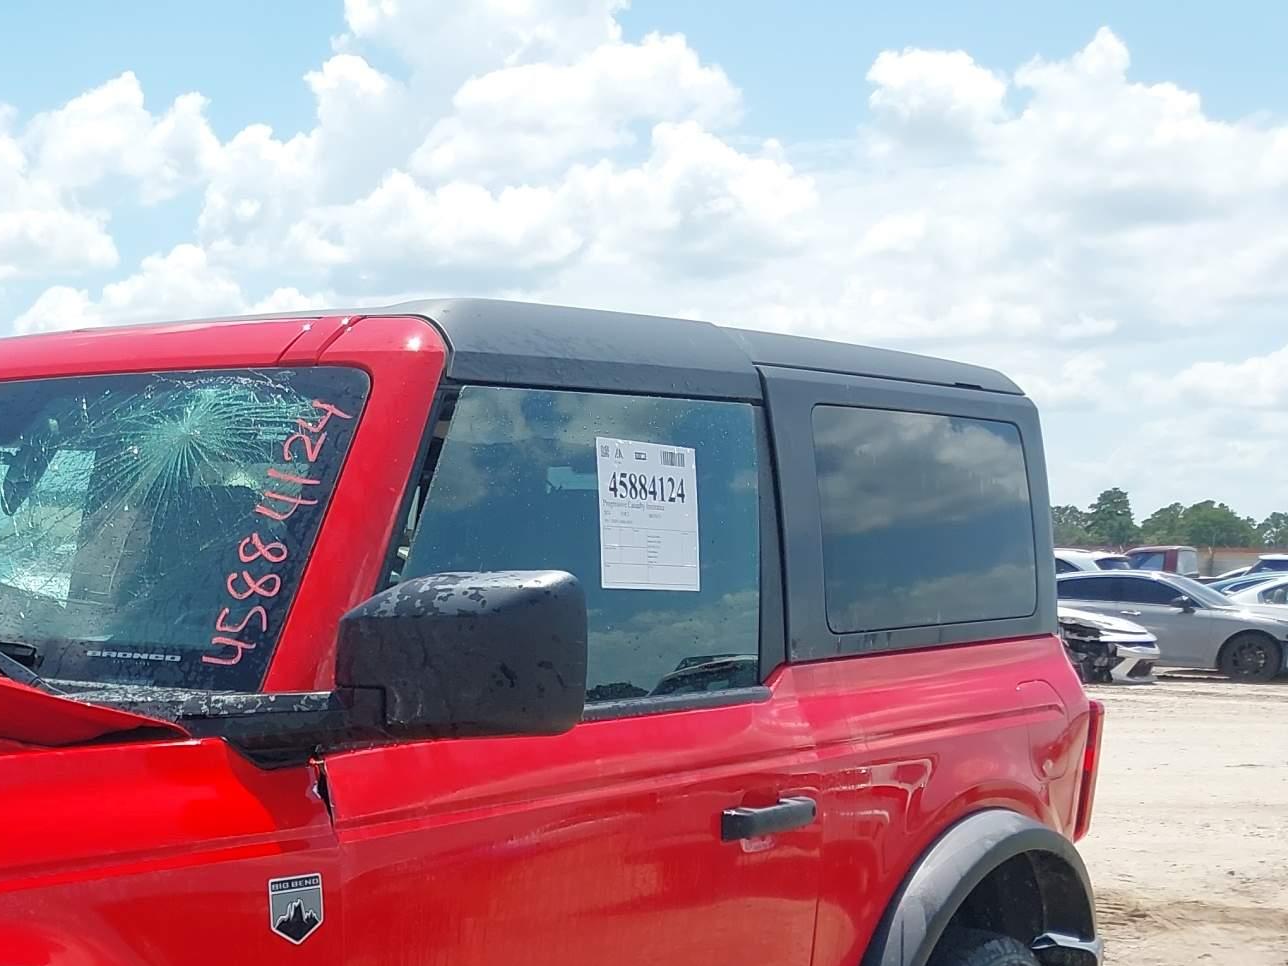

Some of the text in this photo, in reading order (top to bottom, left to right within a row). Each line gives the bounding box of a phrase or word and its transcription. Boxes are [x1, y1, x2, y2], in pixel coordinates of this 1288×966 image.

[608, 471, 686, 504] 45884124
[200, 399, 354, 666] 45884124
[86, 650, 182, 662] BRONCO
[271, 878, 319, 891] BIG BEND
